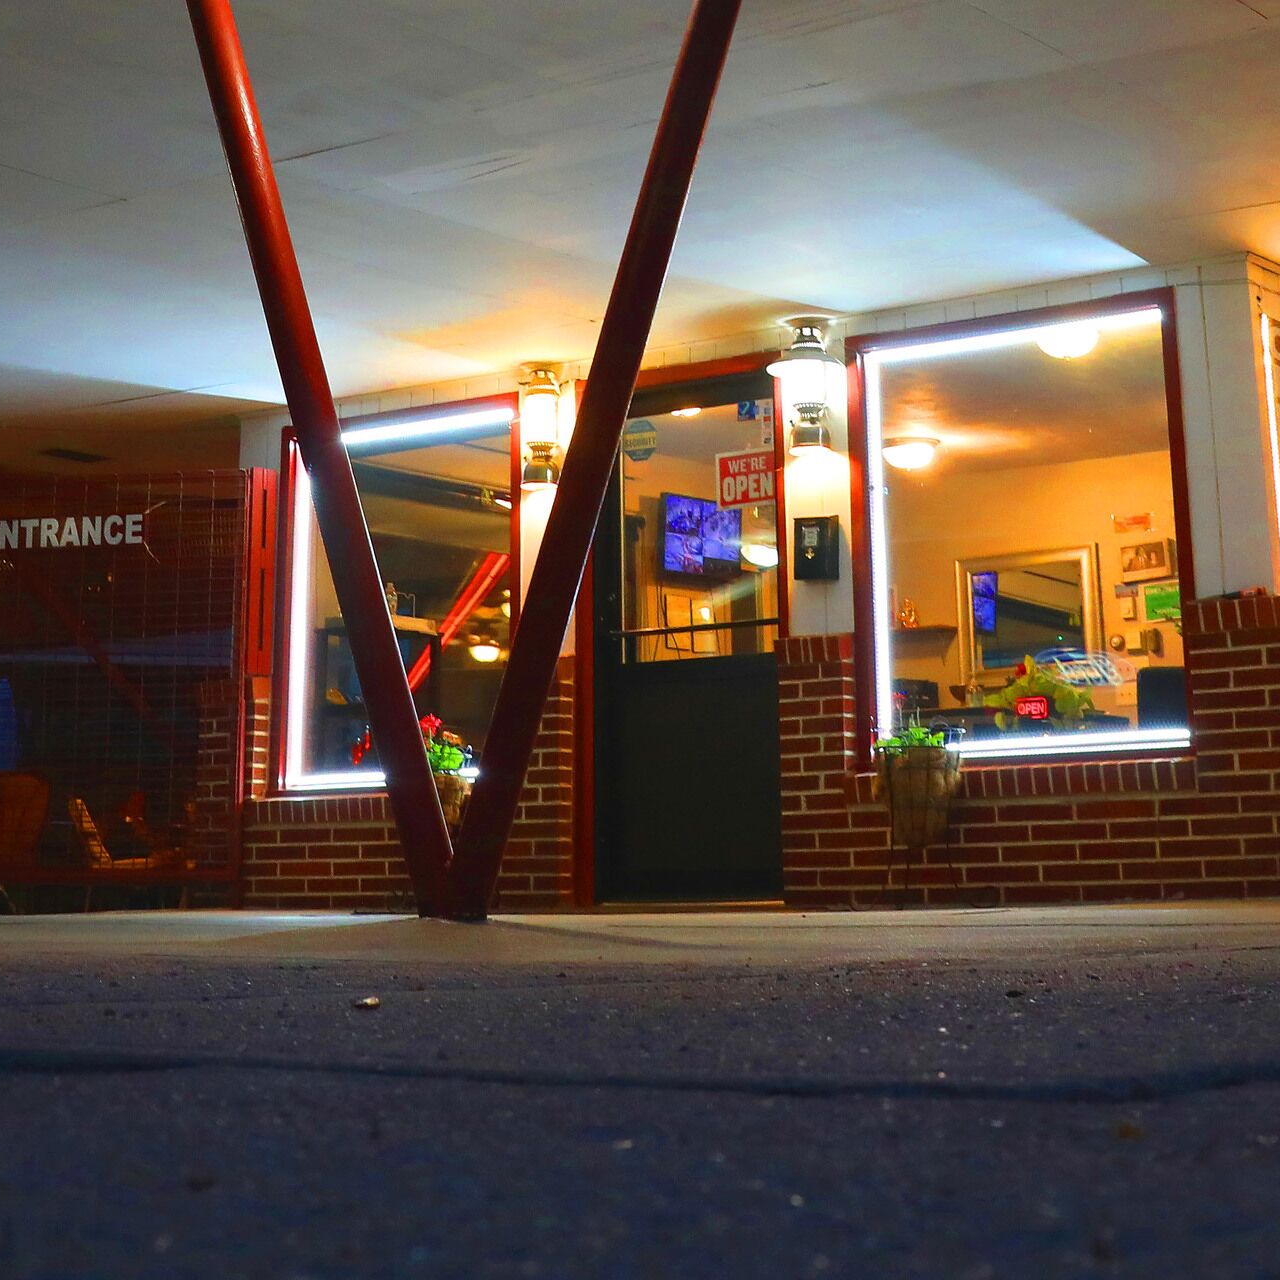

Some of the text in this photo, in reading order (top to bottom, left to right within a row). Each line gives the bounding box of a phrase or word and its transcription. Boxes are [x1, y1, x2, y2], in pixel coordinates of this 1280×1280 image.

[728, 456, 767, 474] WE'RE
[723, 471, 774, 502] OPEN
[1017, 702, 1045, 715] OPEN
